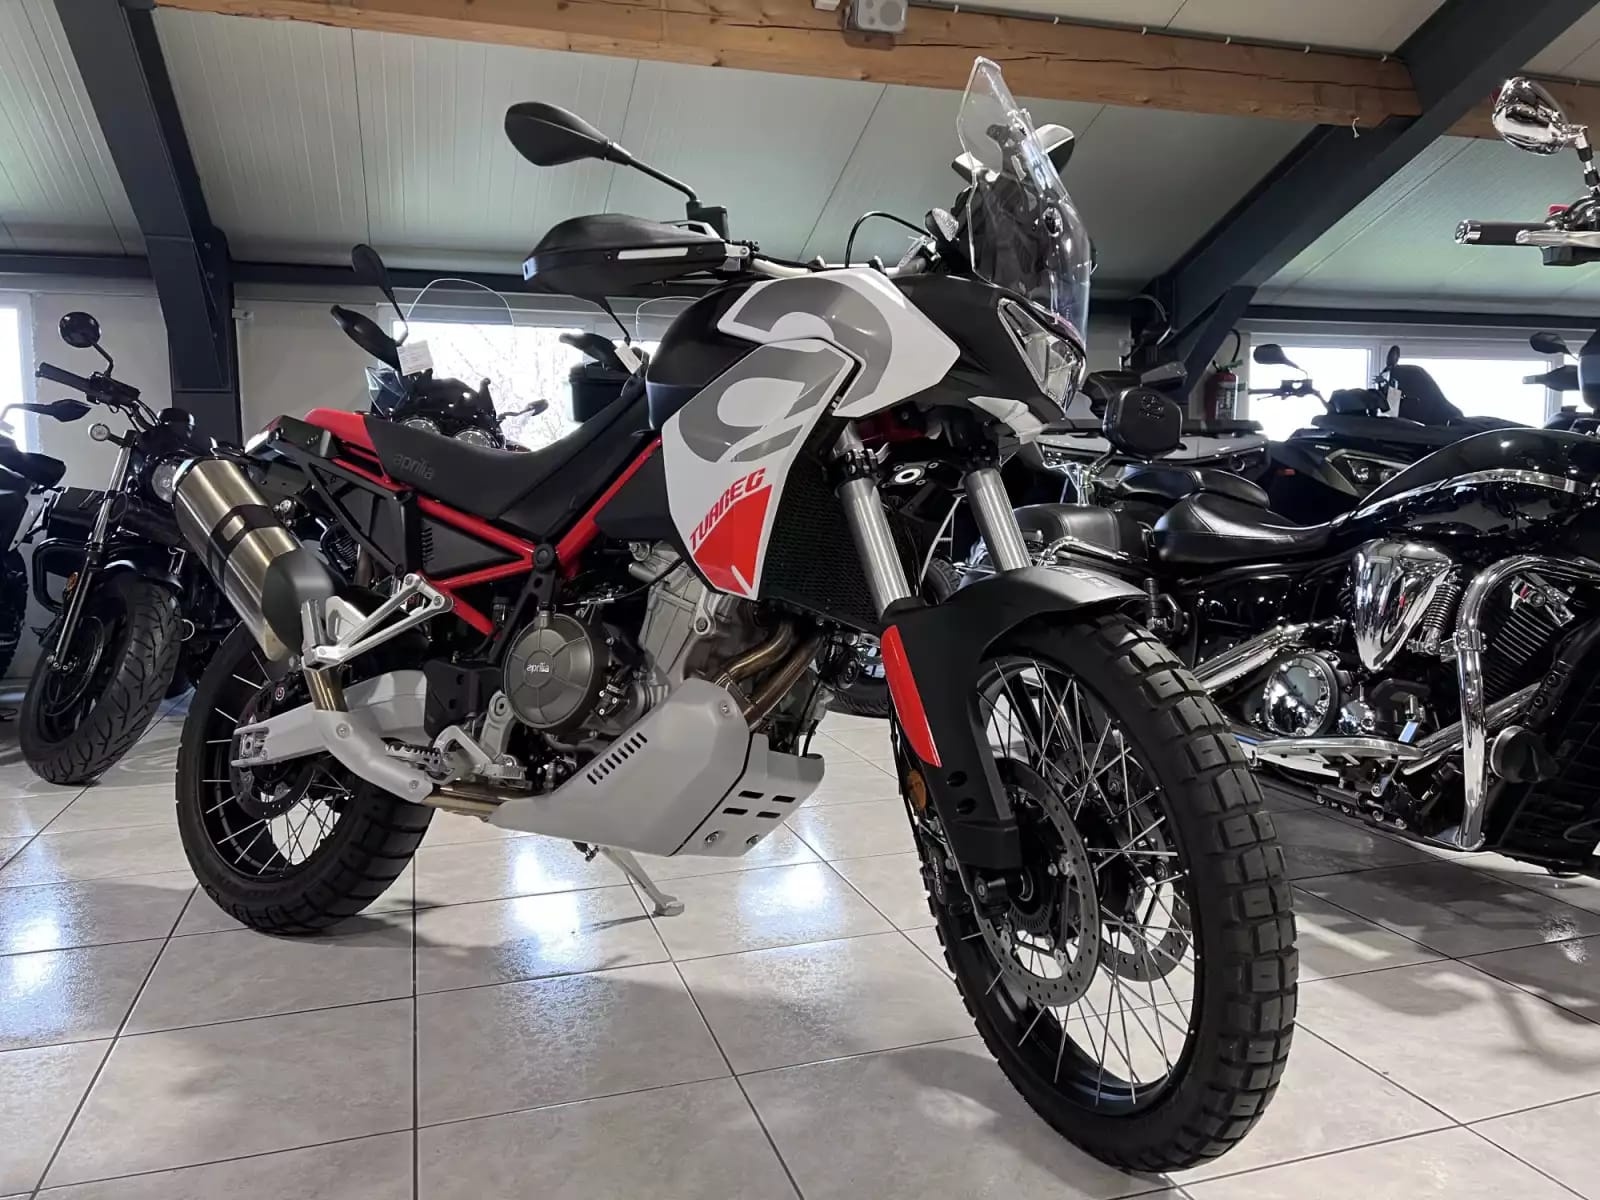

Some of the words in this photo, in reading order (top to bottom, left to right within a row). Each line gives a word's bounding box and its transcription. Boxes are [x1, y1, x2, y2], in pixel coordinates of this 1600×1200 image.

[393, 454, 434, 480] aprilia
[689, 467, 766, 550] TUAREG
[526, 661, 550, 674] aprilia
